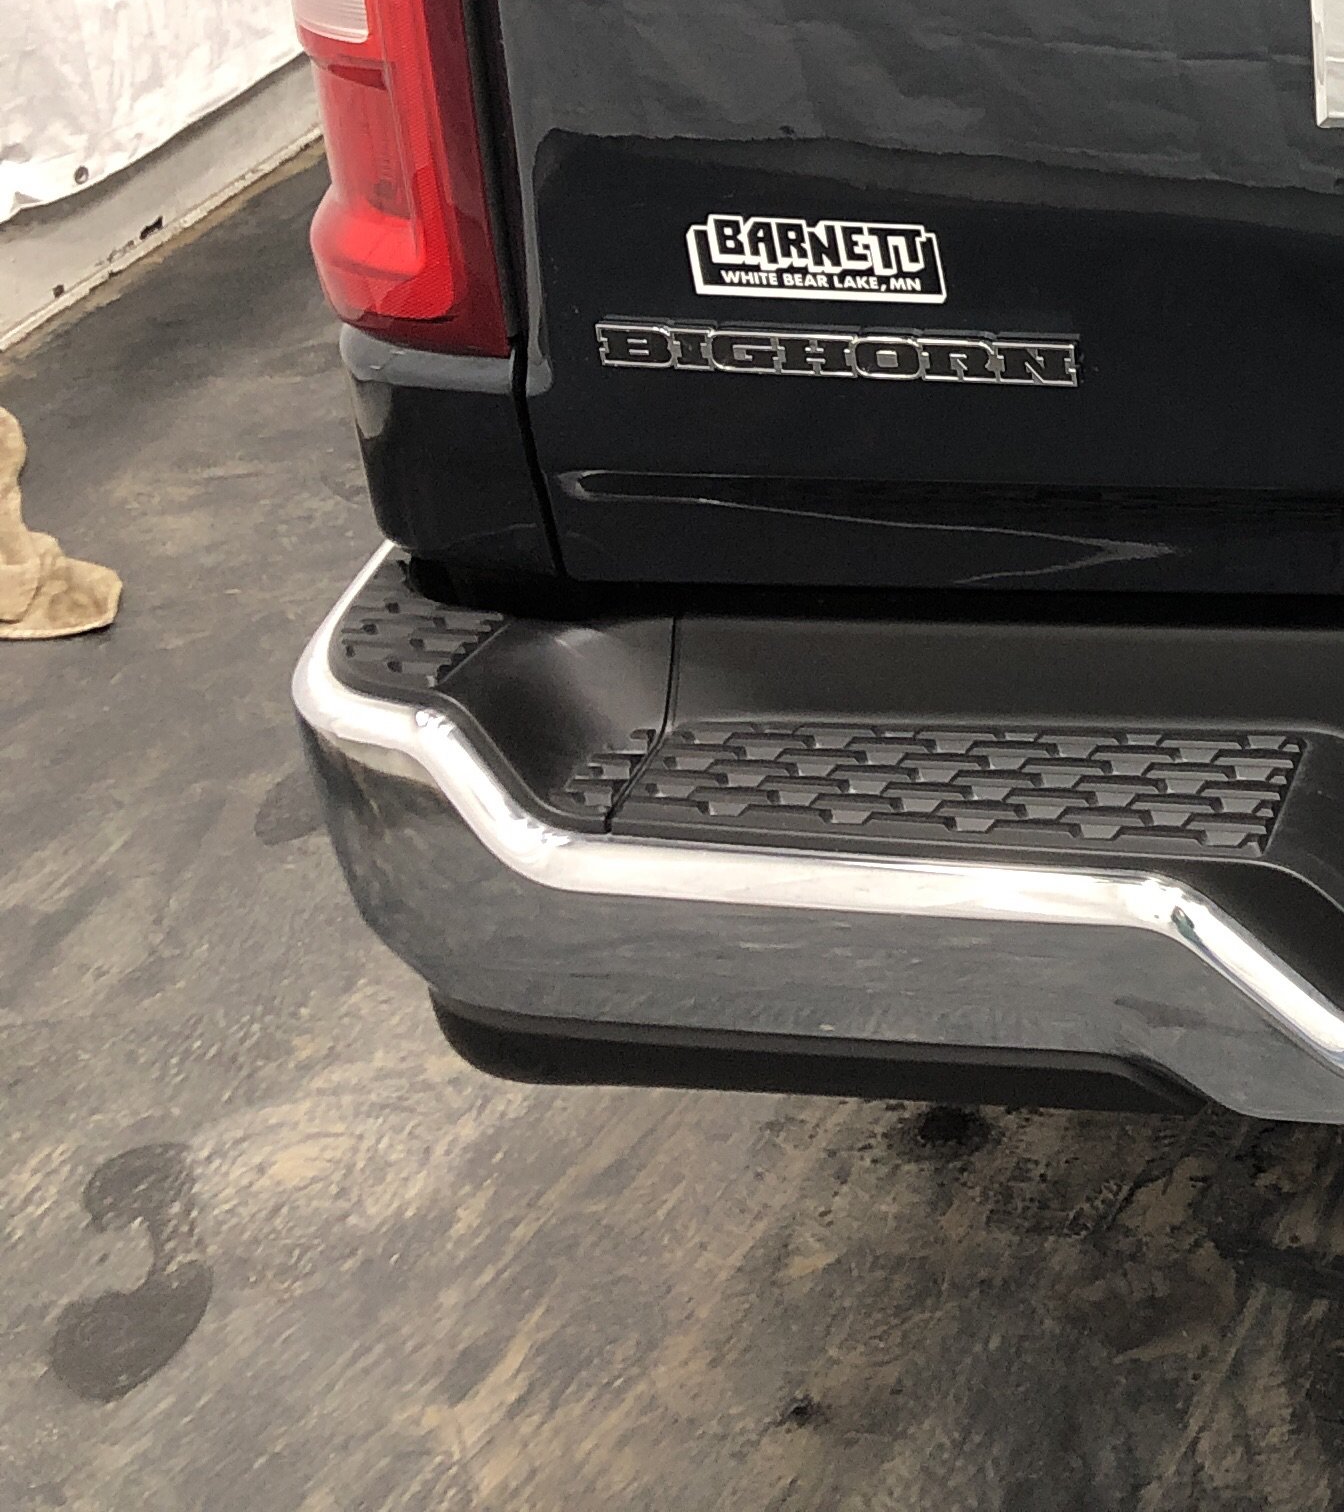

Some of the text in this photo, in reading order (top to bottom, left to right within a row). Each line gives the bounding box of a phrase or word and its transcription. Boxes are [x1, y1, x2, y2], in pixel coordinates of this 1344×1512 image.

[707, 215, 925, 274] BARNETT
[720, 269, 922, 292] WHITE BEAR LAKE, MN
[595, 318, 1080, 388] BIGHORN
